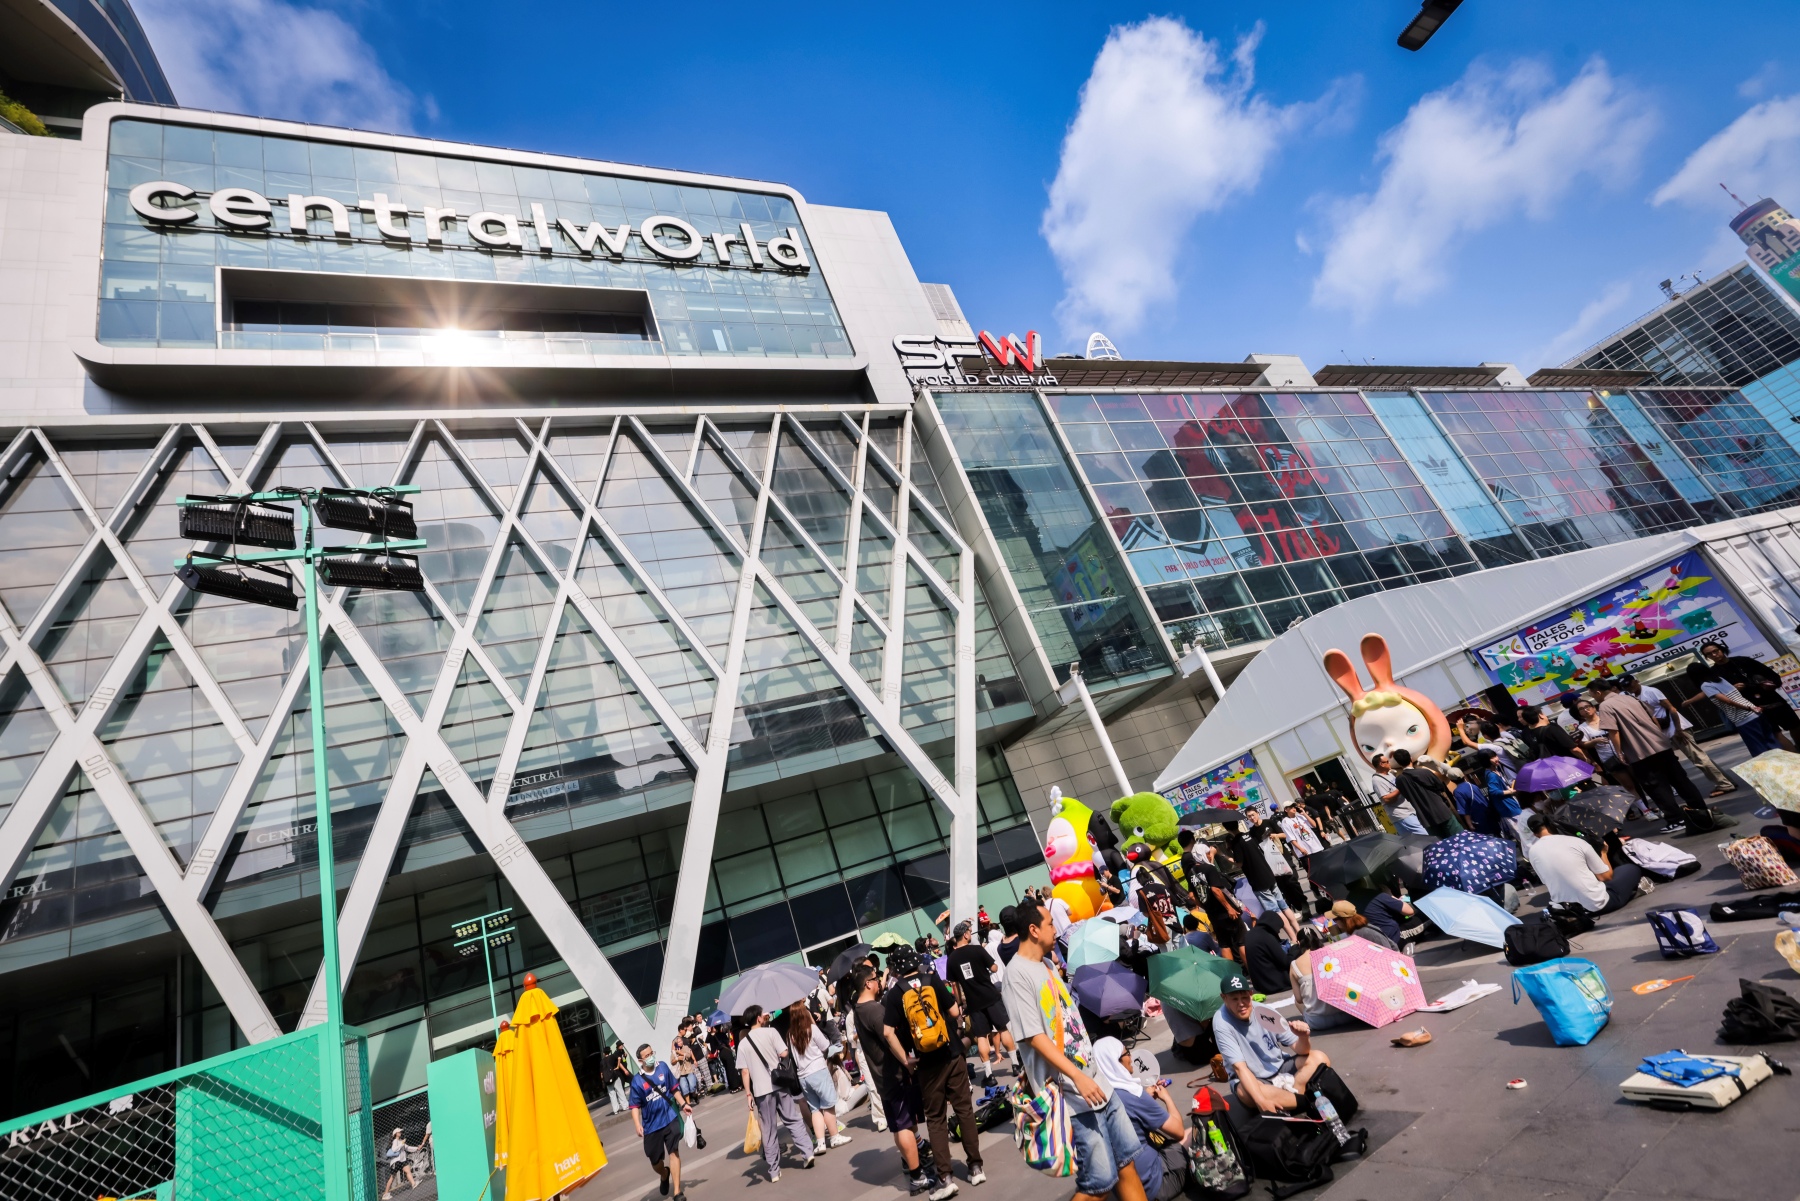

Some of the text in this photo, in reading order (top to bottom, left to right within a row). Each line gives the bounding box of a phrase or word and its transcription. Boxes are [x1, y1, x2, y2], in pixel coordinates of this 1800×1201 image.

[907, 375, 1059, 386] WORLD CINEMA
[1236, 508, 1340, 567] This
[1164, 564, 1179, 573] FIFA
[1529, 623, 1567, 643] TALES
[1534, 624, 1586, 650] OF TOYS
[511, 770, 563, 789] ENTRAL
[256, 822, 333, 844] CENTRA
[3, 881, 53, 900] RAL
[1230, 976, 1243, 988] 名
